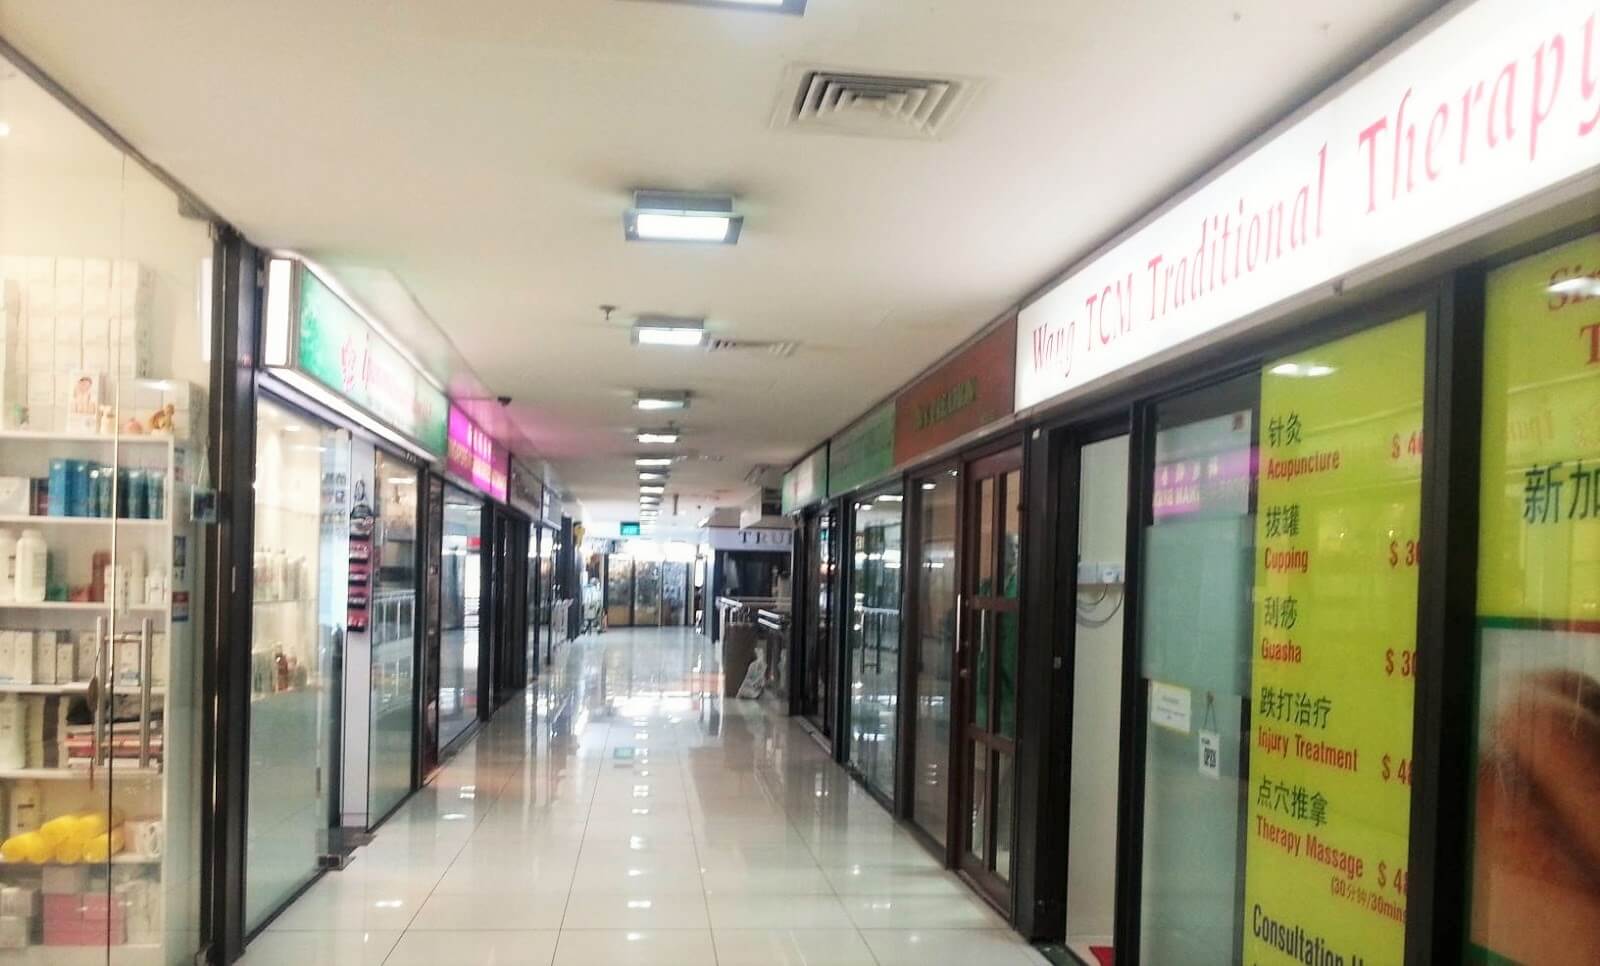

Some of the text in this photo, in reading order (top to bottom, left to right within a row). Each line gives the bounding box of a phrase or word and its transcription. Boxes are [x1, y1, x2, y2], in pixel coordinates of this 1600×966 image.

[1032, 322, 1075, 378] Wang
[1086, 273, 1133, 351] TCM
[1147, 141, 1329, 321] Traditional
[1268, 411, 1302, 448] 针灸
[1267, 450, 1341, 482] Acupuncture
[1524, 458, 1600, 524] 新加
[1265, 503, 1300, 538] 拔罐
[1264, 545, 1309, 573] Cupping
[1264, 596, 1298, 629] 刮痧
[1261, 638, 1302, 663] Guasha
[1260, 687, 1332, 730] 跌打治疗
[1258, 725, 1290, 758] Injury
[1294, 734, 1358, 772] Treatment
[1257, 776, 1328, 829] 点穴推拿
[1257, 815, 1301, 857] Therapy
[1305, 833, 1364, 882] Massage
[1253, 903, 1344, 966] Consultation
